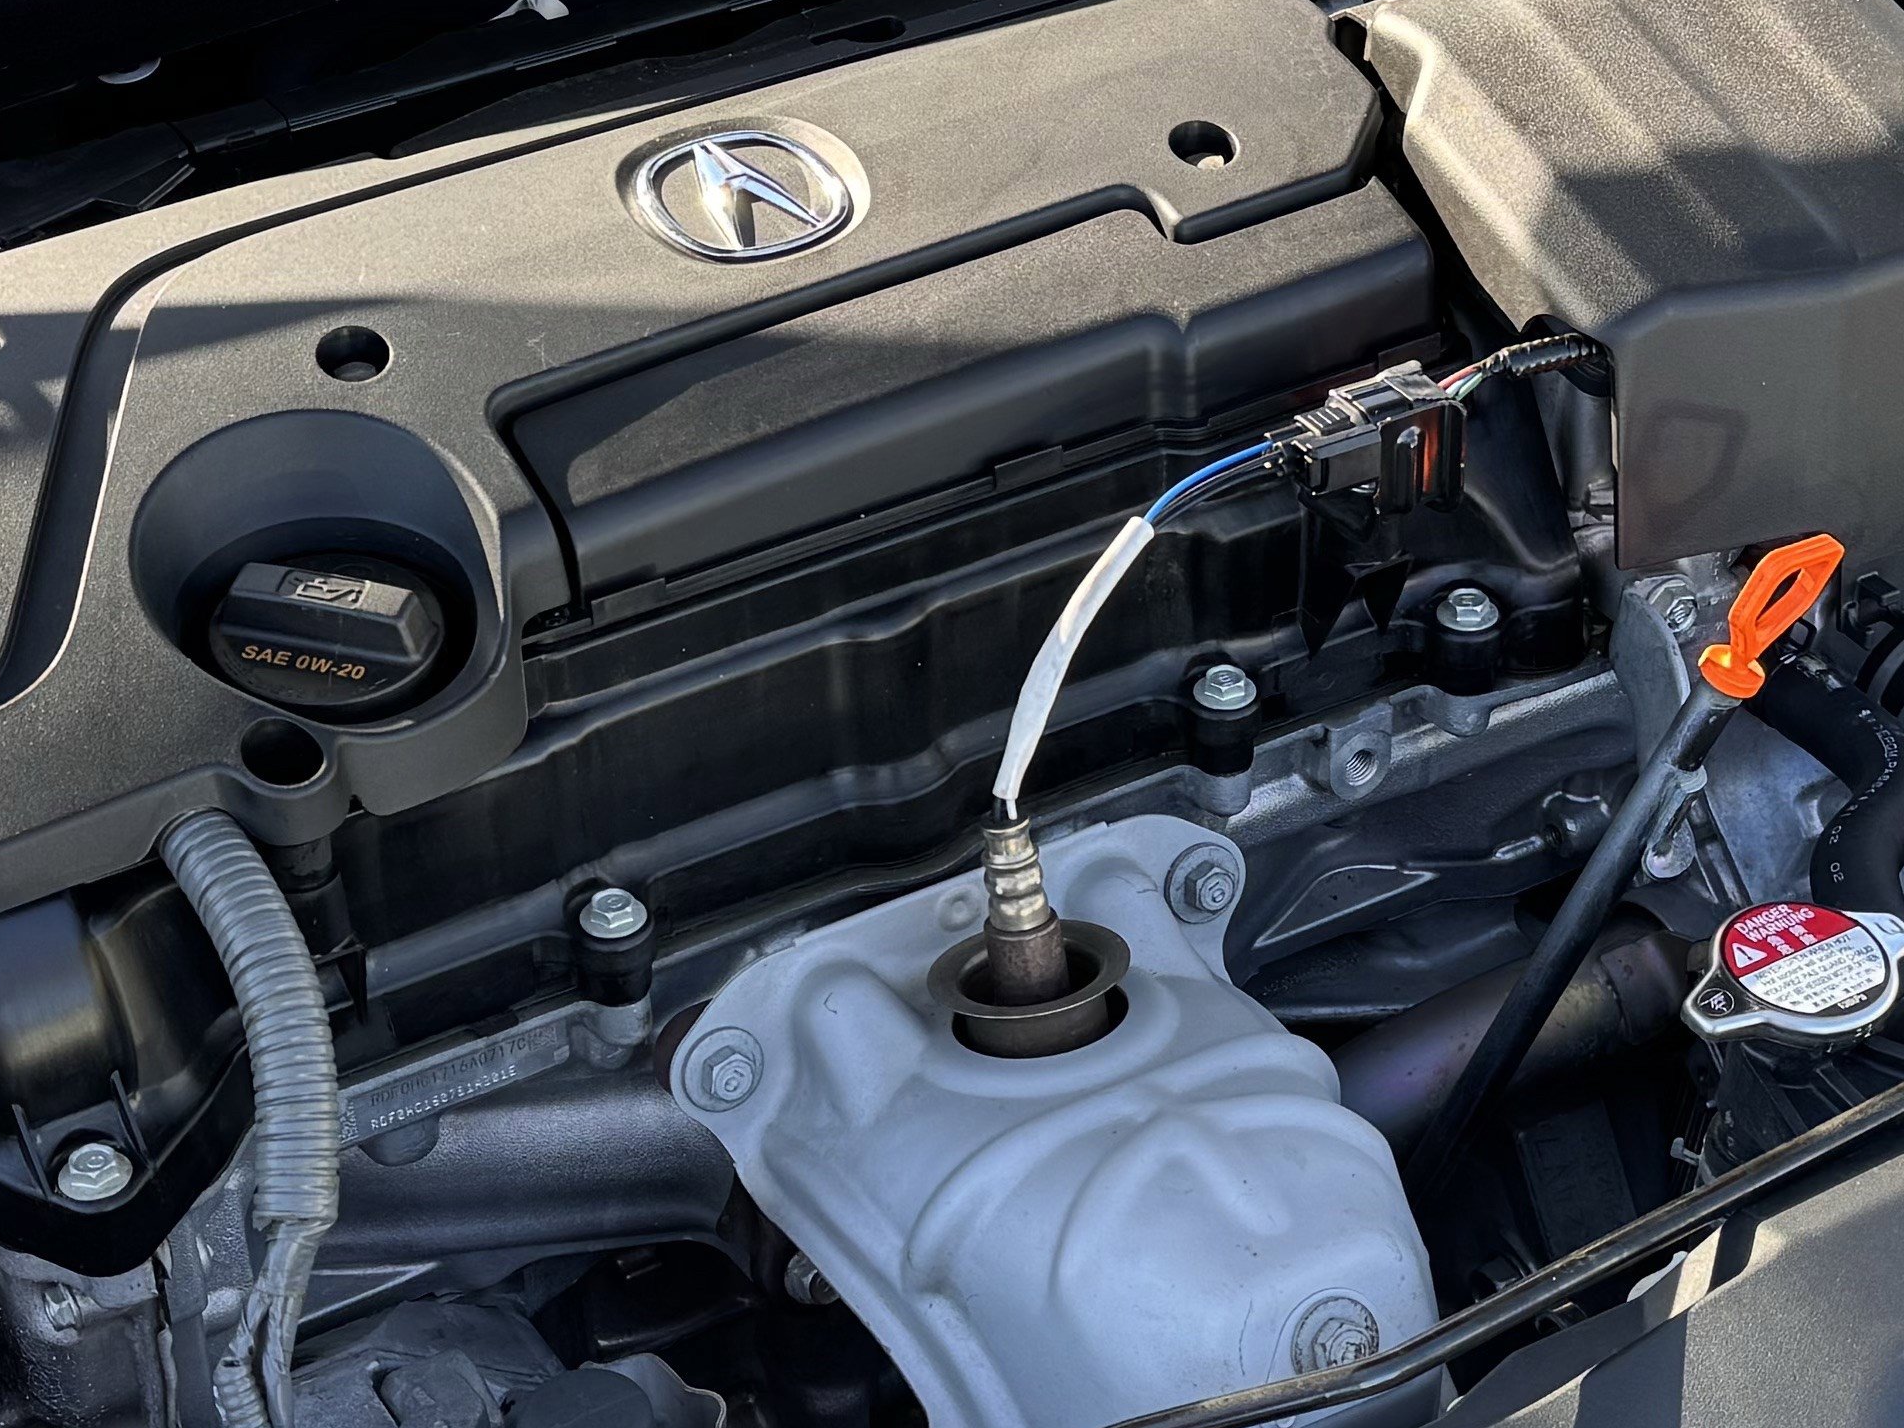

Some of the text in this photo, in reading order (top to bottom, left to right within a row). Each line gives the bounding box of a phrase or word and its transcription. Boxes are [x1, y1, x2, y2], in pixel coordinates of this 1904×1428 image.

[241, 645, 366, 680] SAE 0W-20
[1734, 903, 1793, 934] DANGER
[1745, 908, 1815, 943] WARNUNG
